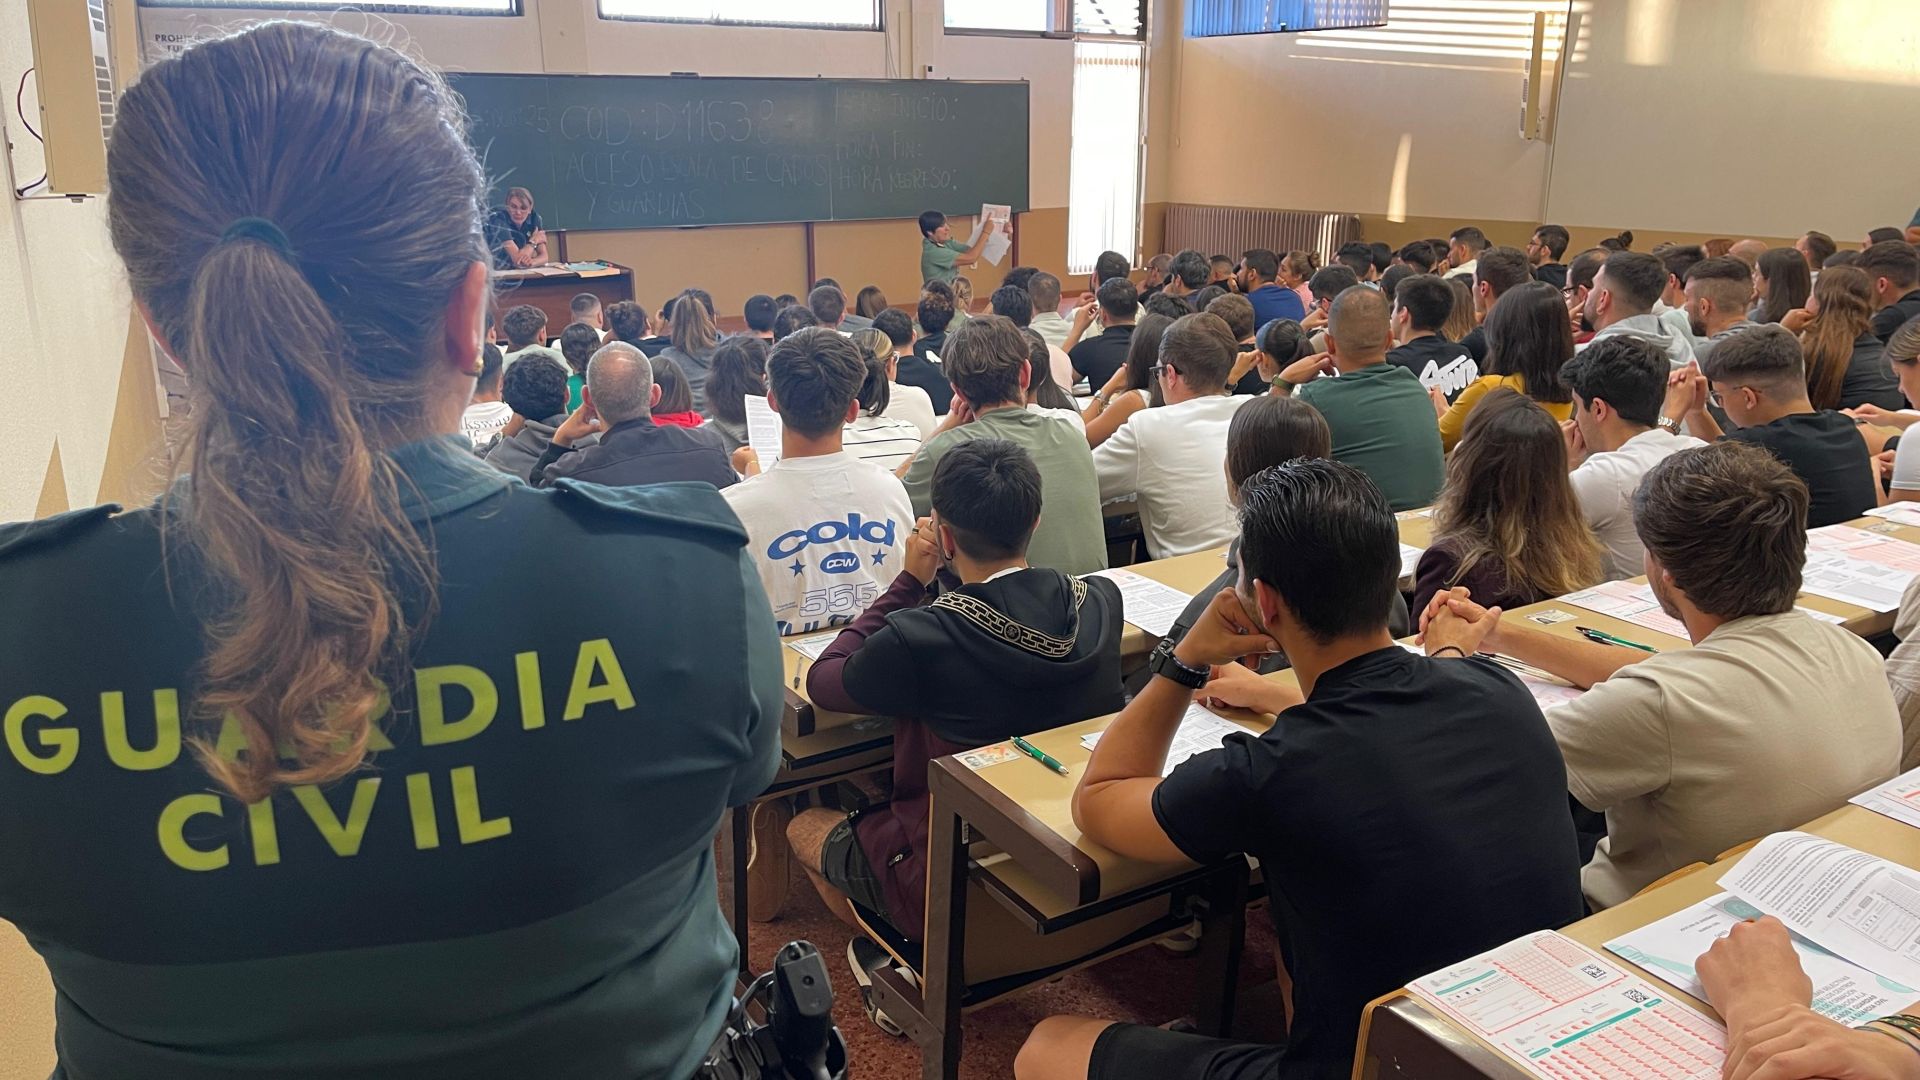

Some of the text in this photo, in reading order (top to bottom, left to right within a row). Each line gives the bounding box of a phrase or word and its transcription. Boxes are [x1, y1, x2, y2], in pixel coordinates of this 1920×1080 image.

[731, 155, 760, 184] DE
[585, 187, 705, 222] Y GUARDIAS
[767, 513, 896, 560] cold
[4, 638, 636, 775] GUDIA
[157, 766, 512, 871] CIVIL
